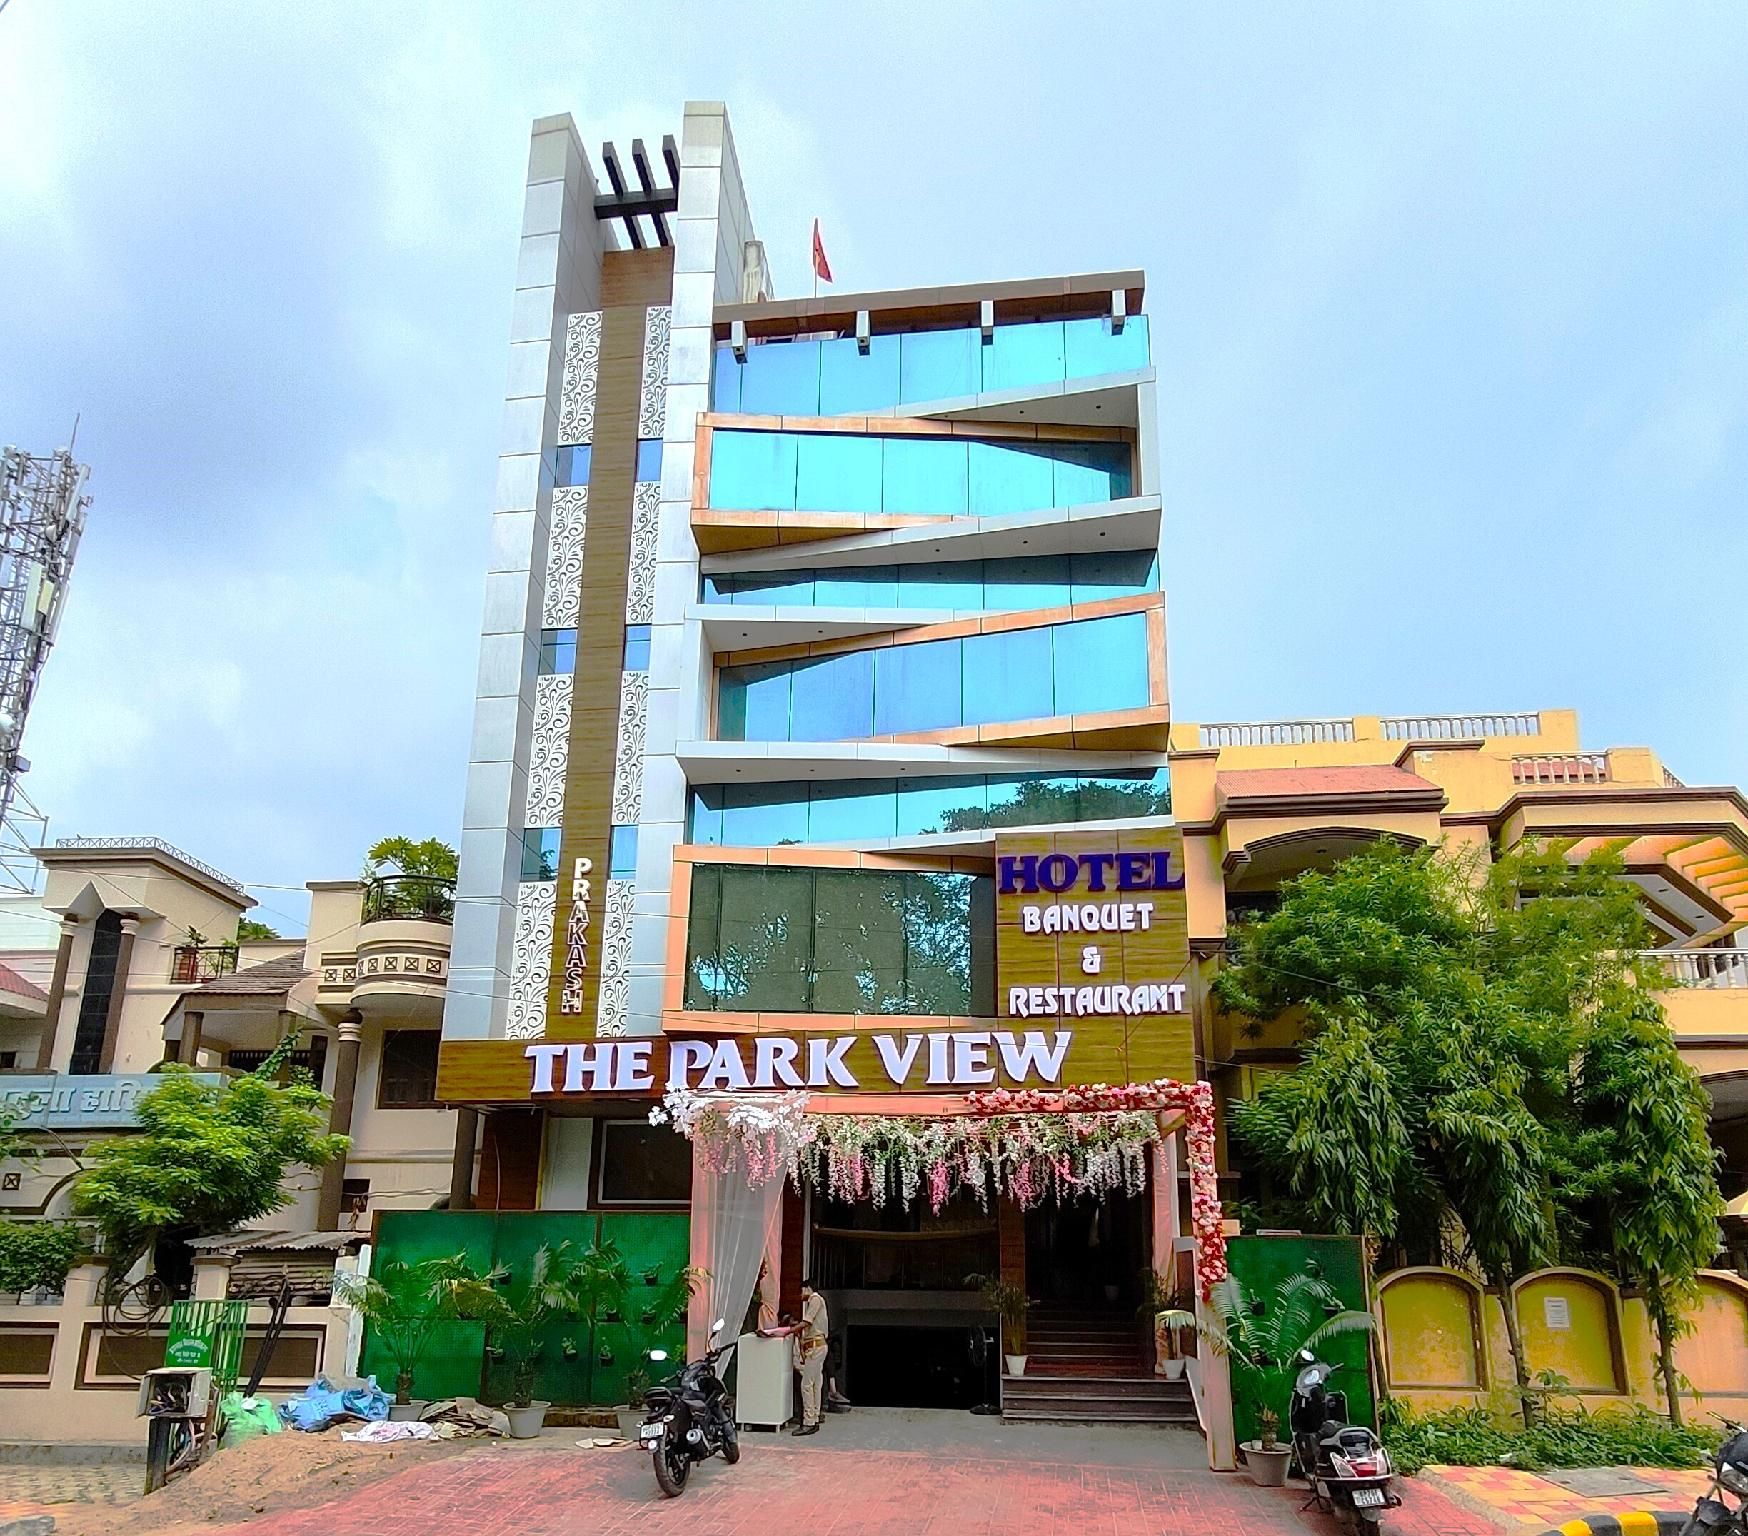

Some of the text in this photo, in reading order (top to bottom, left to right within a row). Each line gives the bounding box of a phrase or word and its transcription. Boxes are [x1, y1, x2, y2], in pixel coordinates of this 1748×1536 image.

[998, 852, 1186, 893] HOTEL
[561, 857, 593, 1014] PRAKASH
[1022, 903, 1154, 934] BANQUET
[1081, 946, 1101, 974] &
[1009, 984, 1186, 1018] RESTAURANT
[524, 1031, 1072, 1093] THE PARK VIEW
